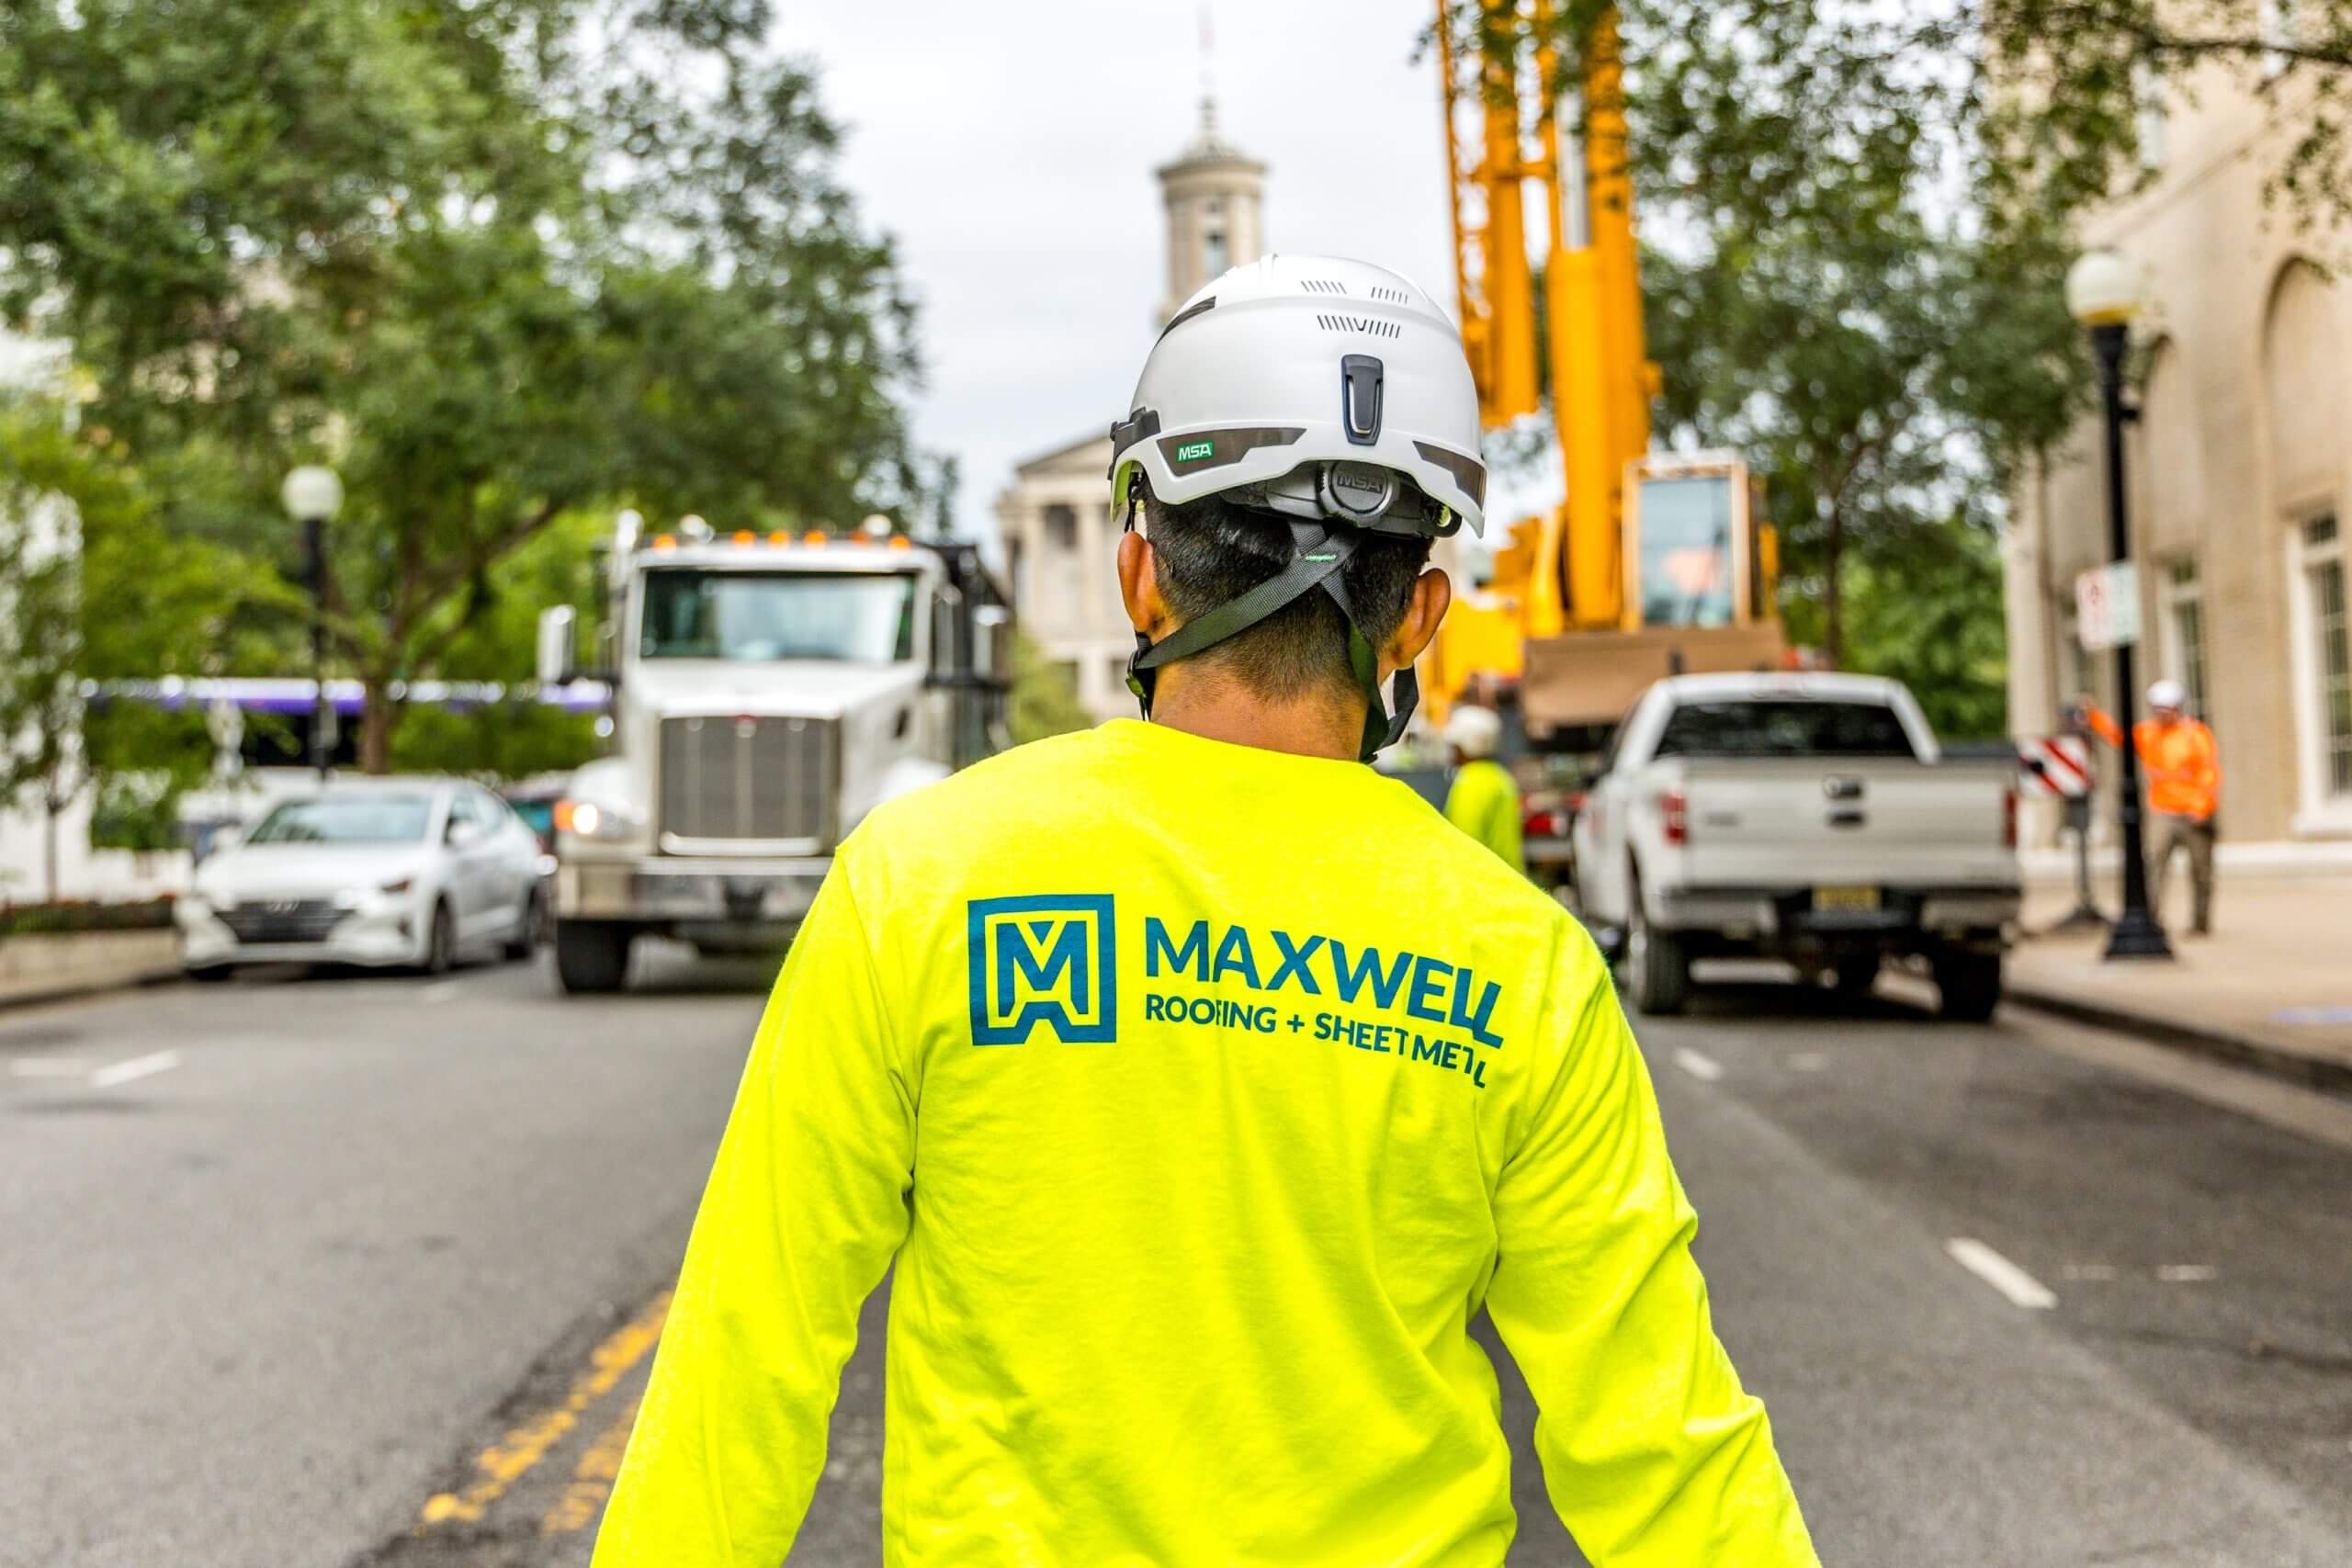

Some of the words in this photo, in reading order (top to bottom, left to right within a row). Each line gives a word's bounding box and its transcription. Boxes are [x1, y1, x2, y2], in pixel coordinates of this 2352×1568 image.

[1179, 444, 1212, 461] MSA
[1338, 475, 1383, 493] MSA
[1145, 917, 1503, 1049] MAXWELL
[1286, 1014, 1306, 1033] +
[1314, 1012, 1409, 1055] SHEET
[1411, 1034, 1486, 1089] METL
